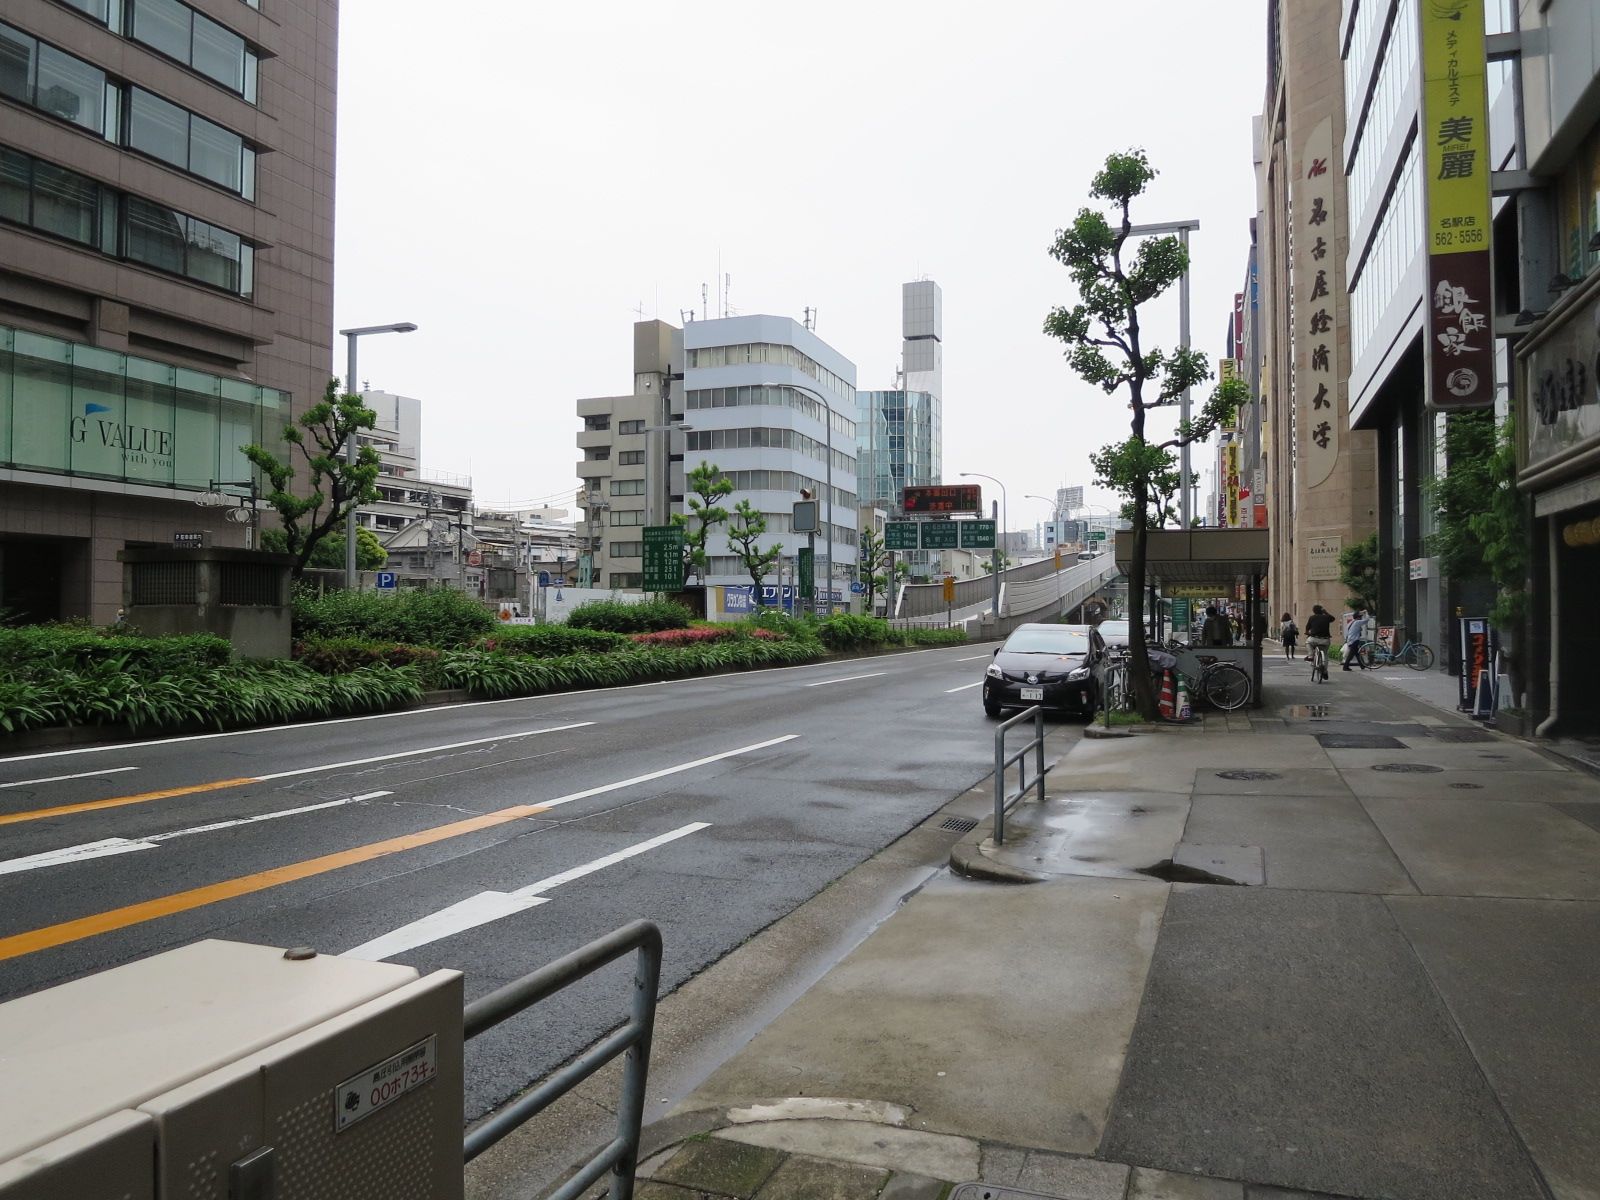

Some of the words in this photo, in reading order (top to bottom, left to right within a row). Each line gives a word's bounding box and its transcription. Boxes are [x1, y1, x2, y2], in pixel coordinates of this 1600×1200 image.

[1446, 29, 1461, 108] メディカルエステ
[1437, 116, 1476, 180] 美麗
[1442, 144, 1469, 152] MIREI
[1440, 215, 1476, 228] 名駅店
[1435, 229, 1483, 246] 562-5556
[1308, 197, 1333, 449] 名古屋経済大学
[70, 415, 87, 443] G
[99, 420, 172, 456] VALUE
[121, 452, 147, 464] with
[152, 458, 172, 468] you
[380, 574, 392, 587] P
